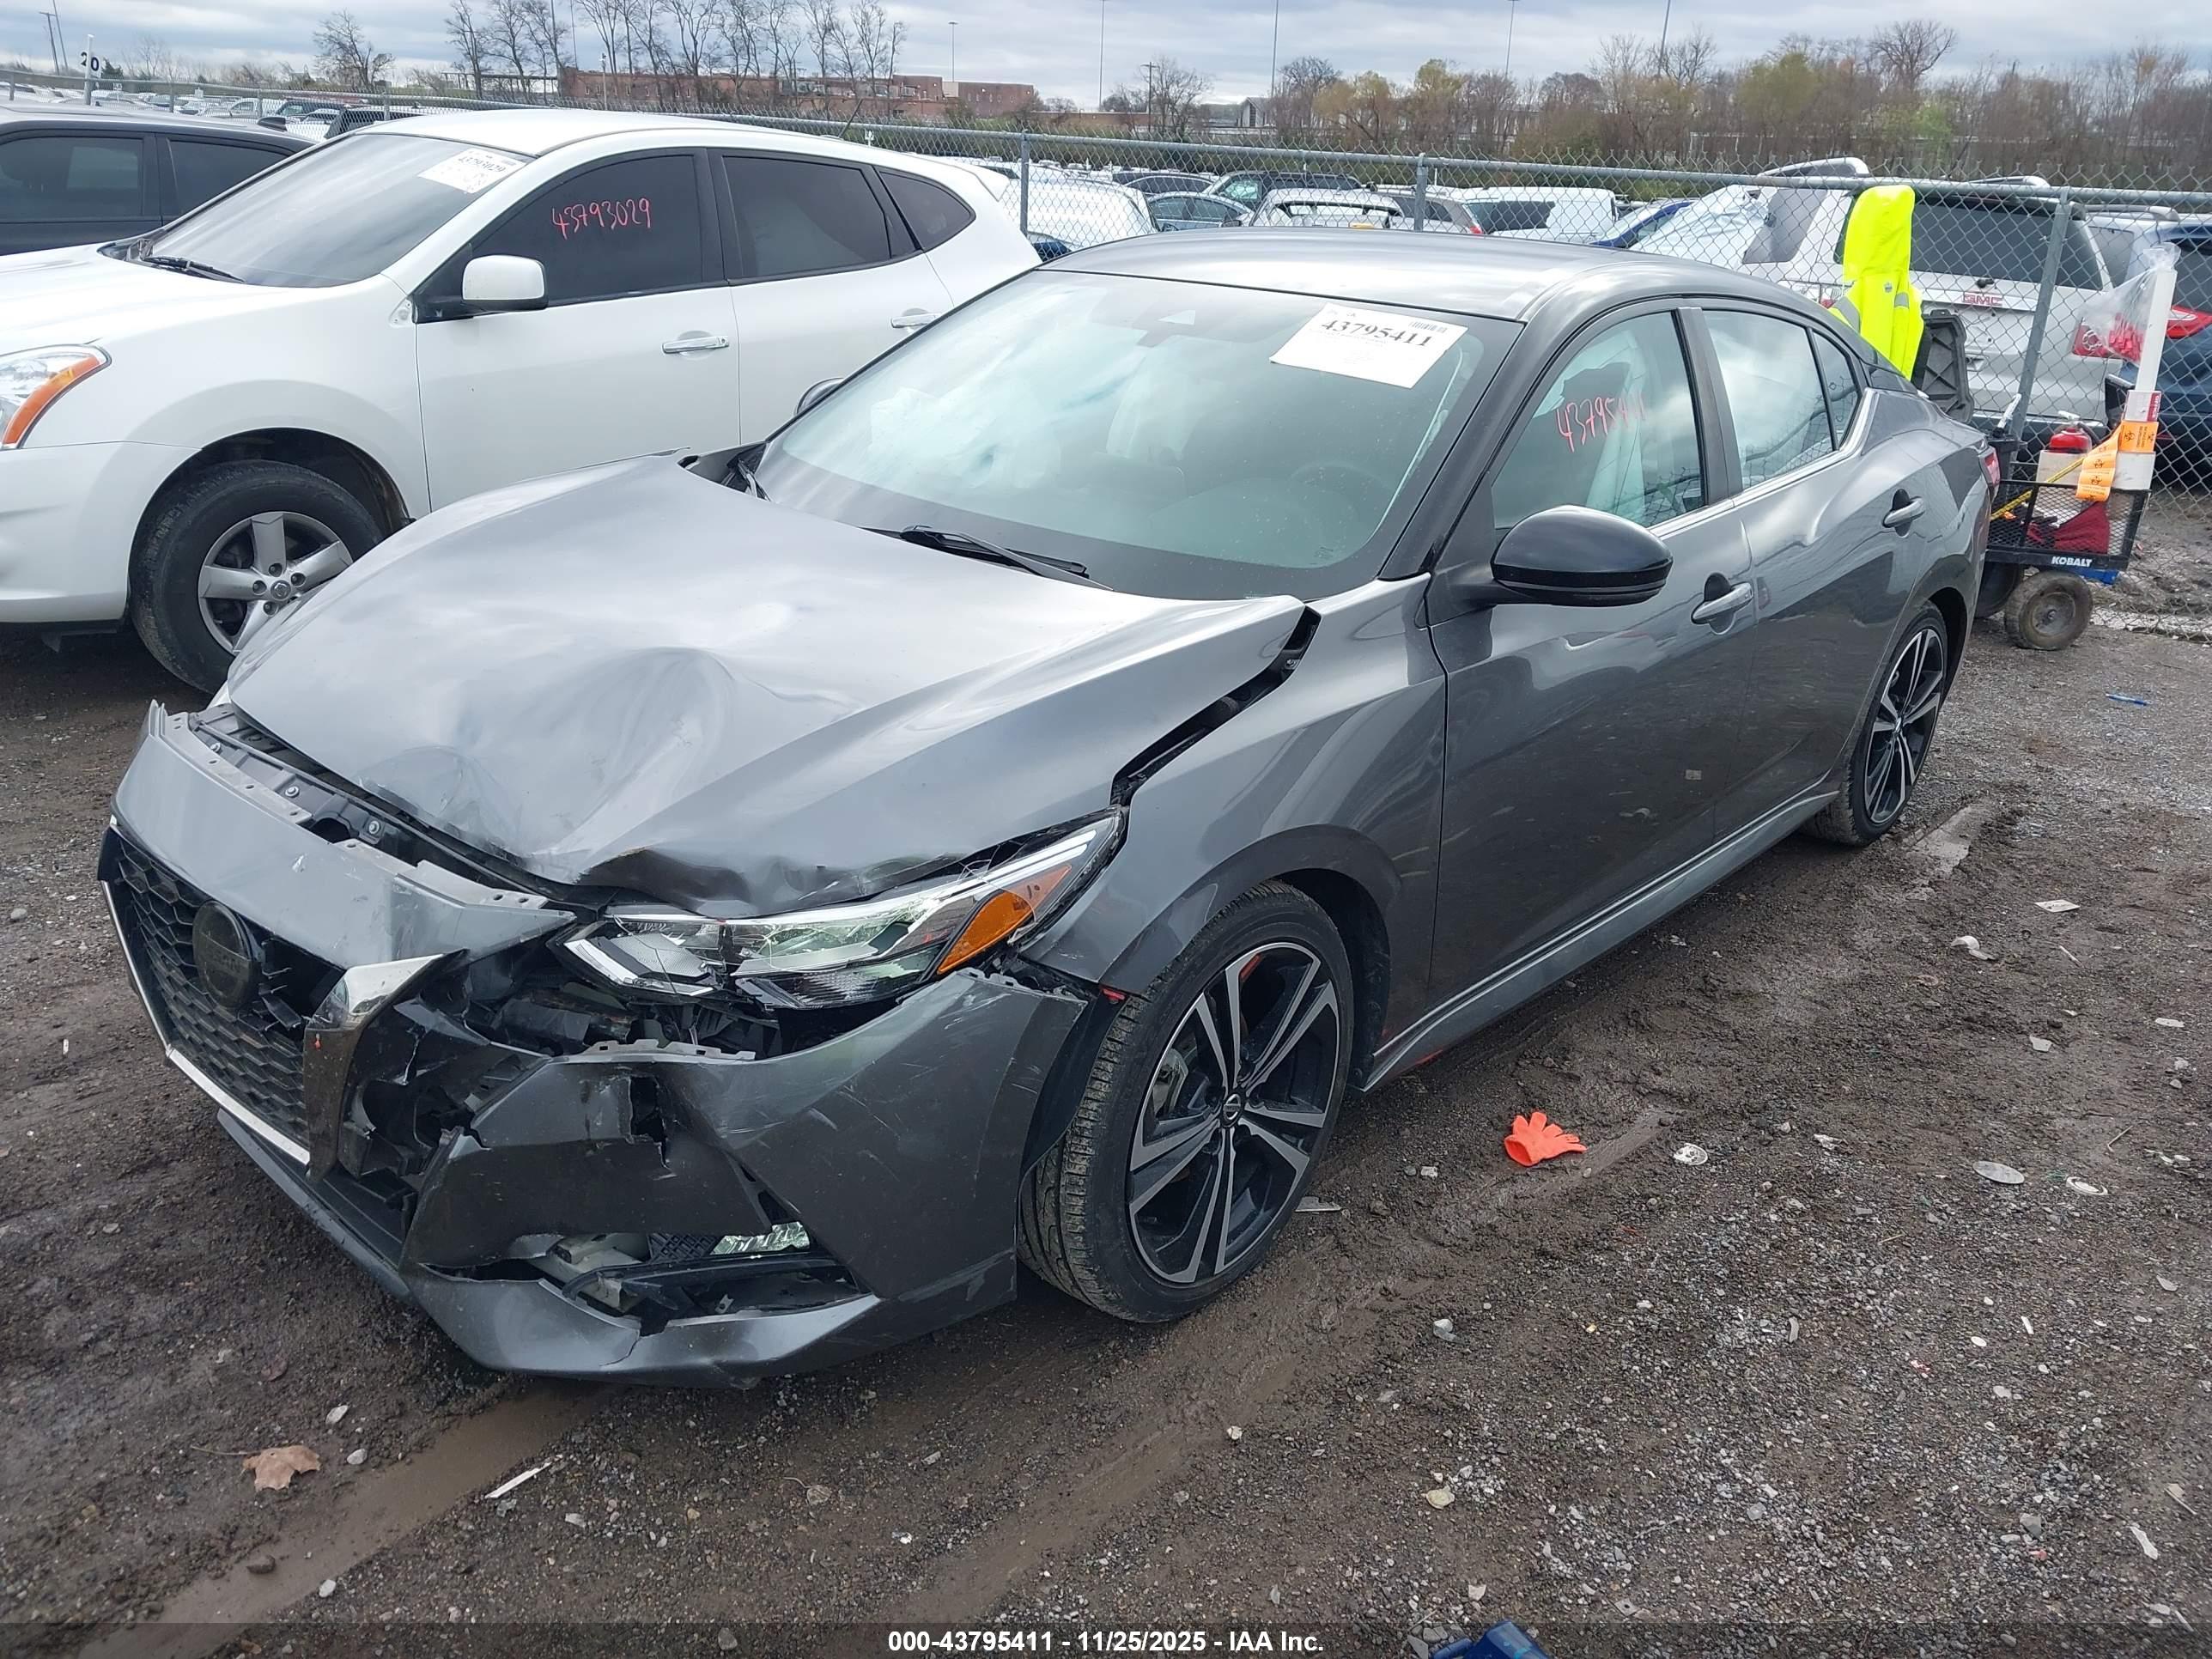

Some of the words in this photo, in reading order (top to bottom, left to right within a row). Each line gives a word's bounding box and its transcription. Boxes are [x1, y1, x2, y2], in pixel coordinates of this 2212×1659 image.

[80, 52, 100, 71] 20
[551, 198, 651, 240] 43793029
[1963, 294, 2002, 307] GMC
[1321, 319, 1433, 347] 43795411
[2051, 556, 2093, 568] KOBALT
